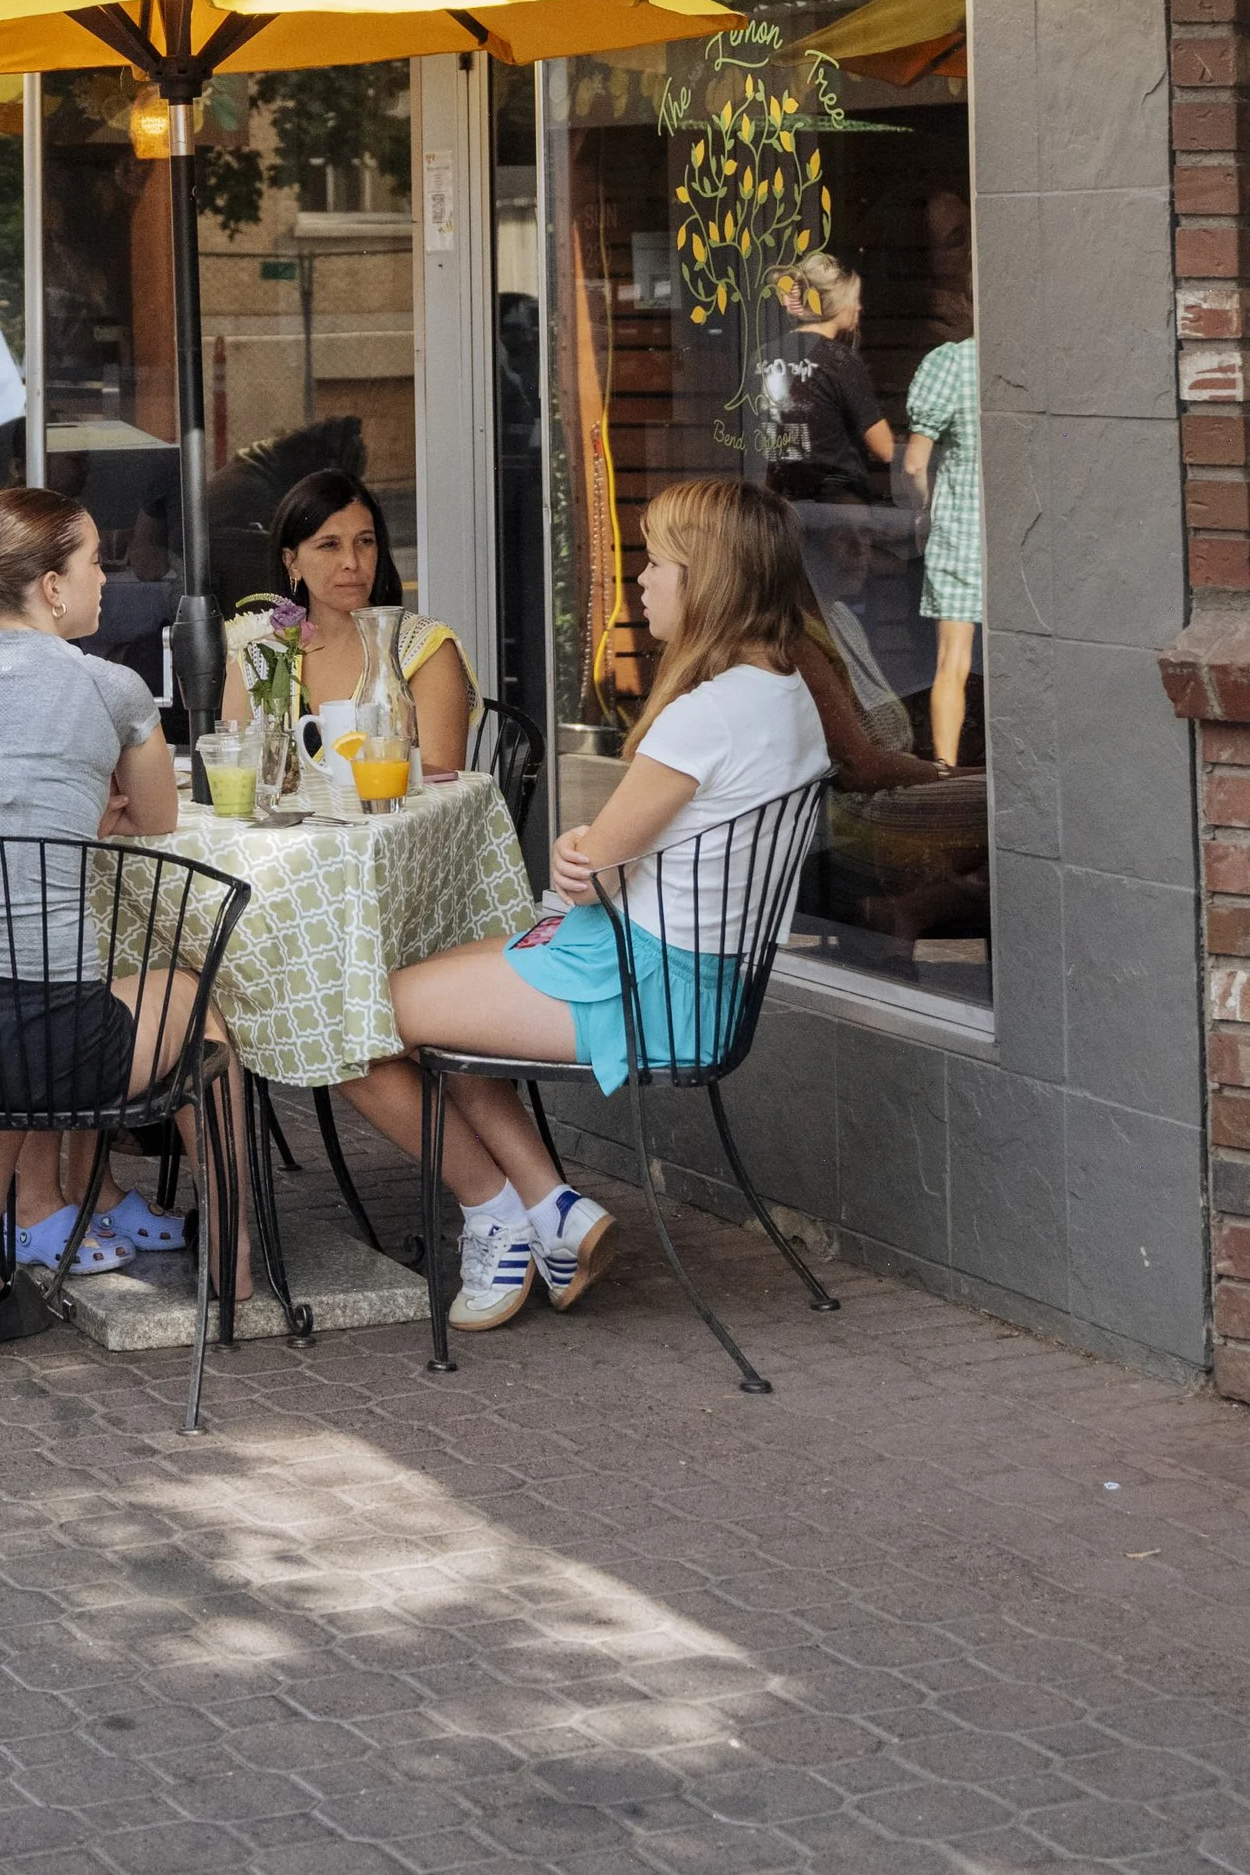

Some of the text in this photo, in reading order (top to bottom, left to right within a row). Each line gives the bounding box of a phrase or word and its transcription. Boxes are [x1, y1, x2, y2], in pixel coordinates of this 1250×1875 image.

[658, 19, 844, 137] The Lemon Tree
[713, 419, 748, 457] Bend,
